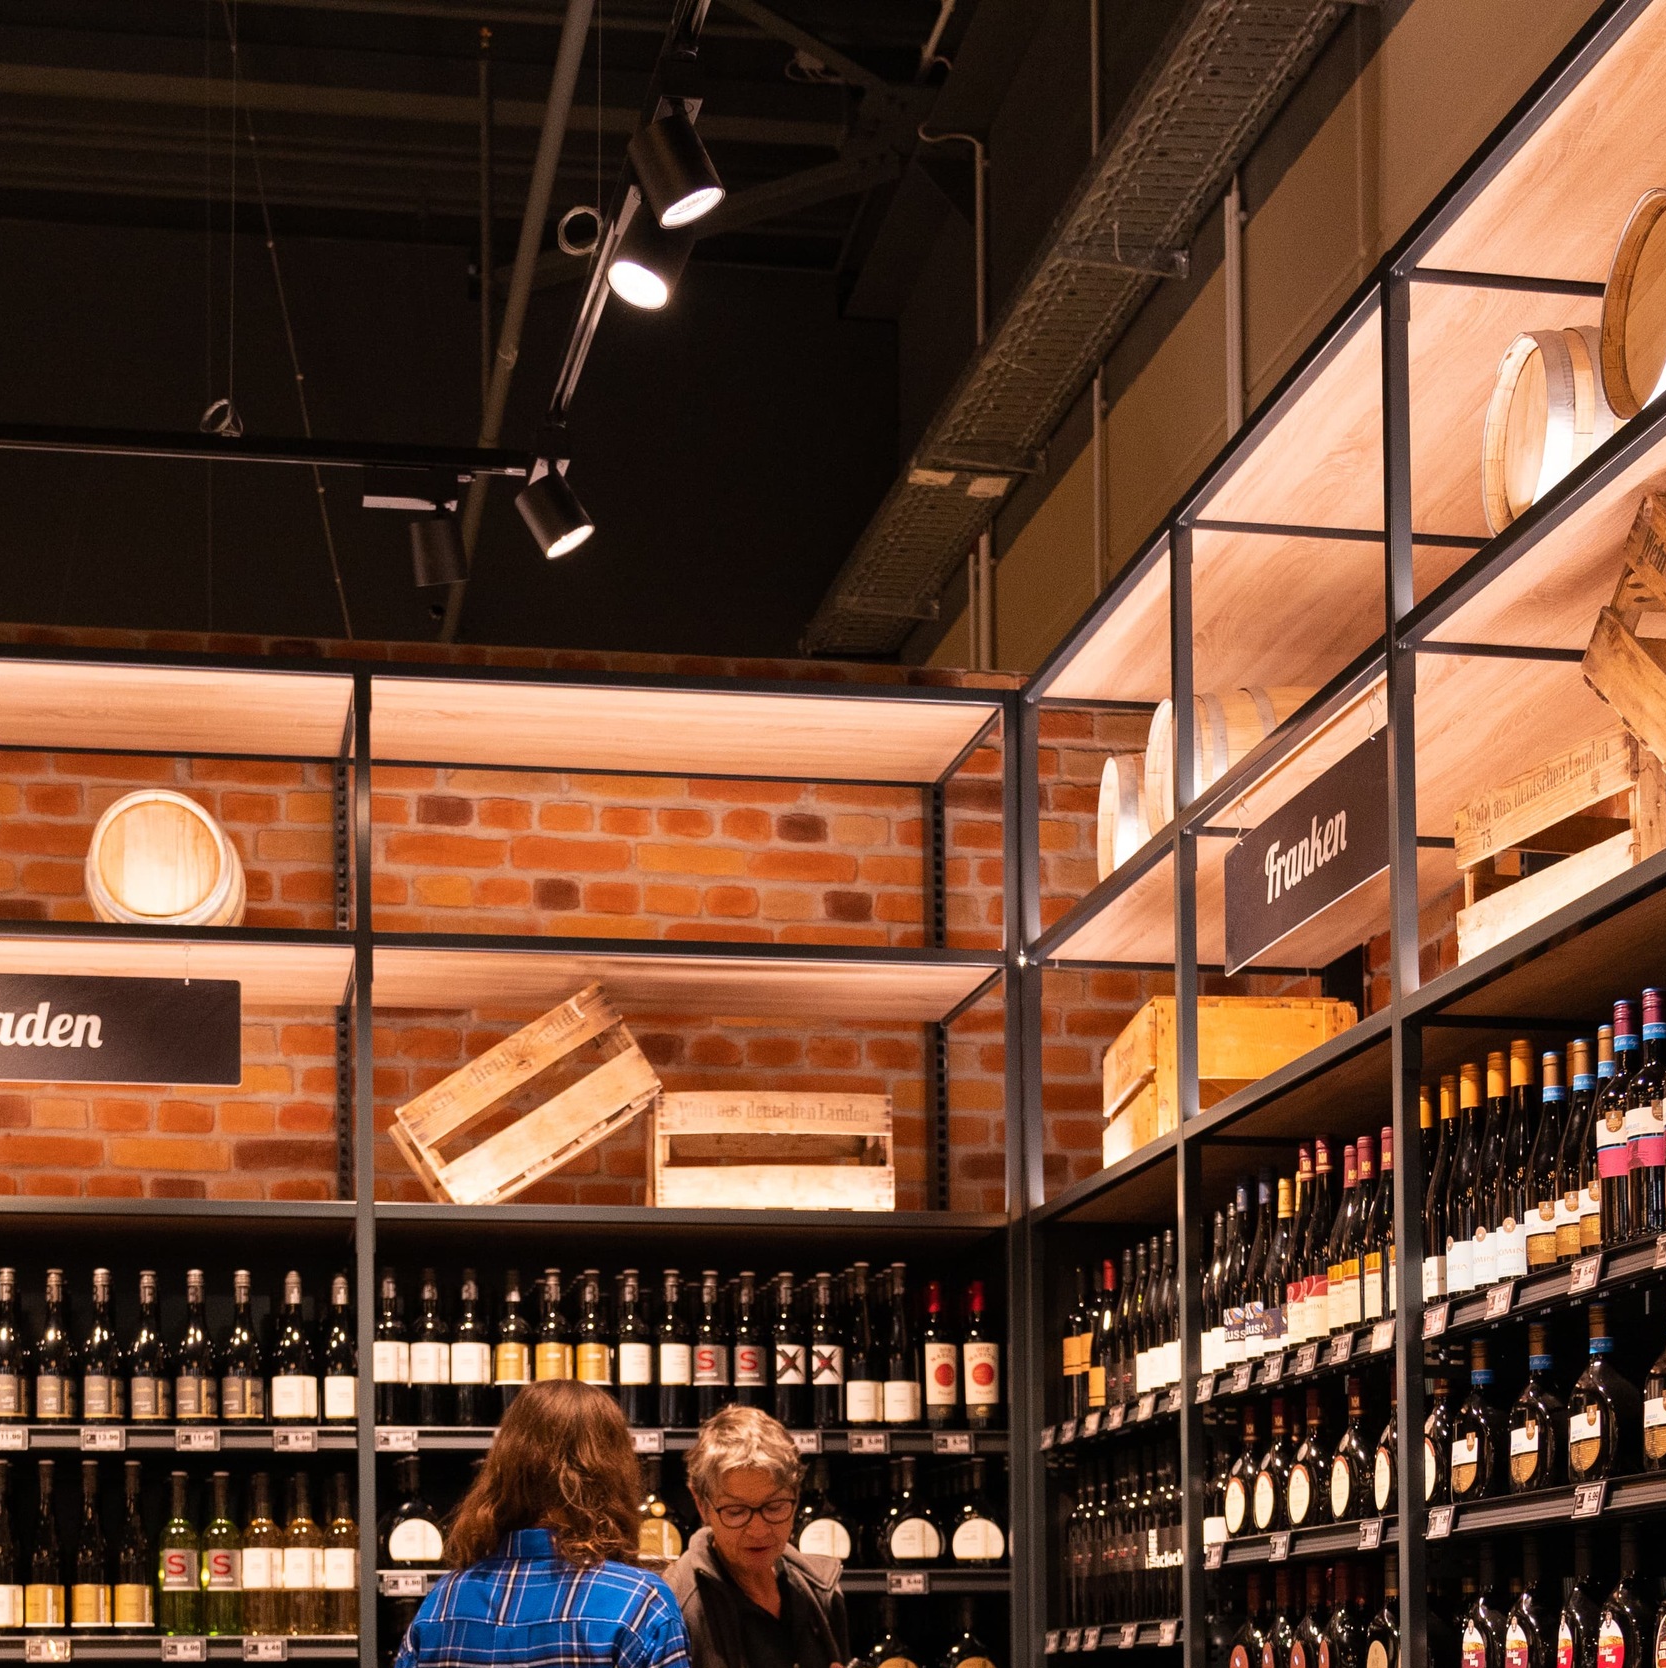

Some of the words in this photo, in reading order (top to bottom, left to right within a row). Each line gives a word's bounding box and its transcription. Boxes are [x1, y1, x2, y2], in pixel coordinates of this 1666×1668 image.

[1643, 529, 1666, 572] Wein
[1493, 795, 1512, 822] aus
[1514, 760, 1568, 815] deutschen
[1480, 827, 1494, 850] 73
[1265, 810, 1348, 905] Franken
[717, 1104, 743, 1118] aus
[747, 1101, 817, 1119] deutschen
[697, 1350, 715, 1371] S
[740, 1350, 757, 1371] S
[167, 1553, 187, 1576] S
[213, 1553, 232, 1576] S
